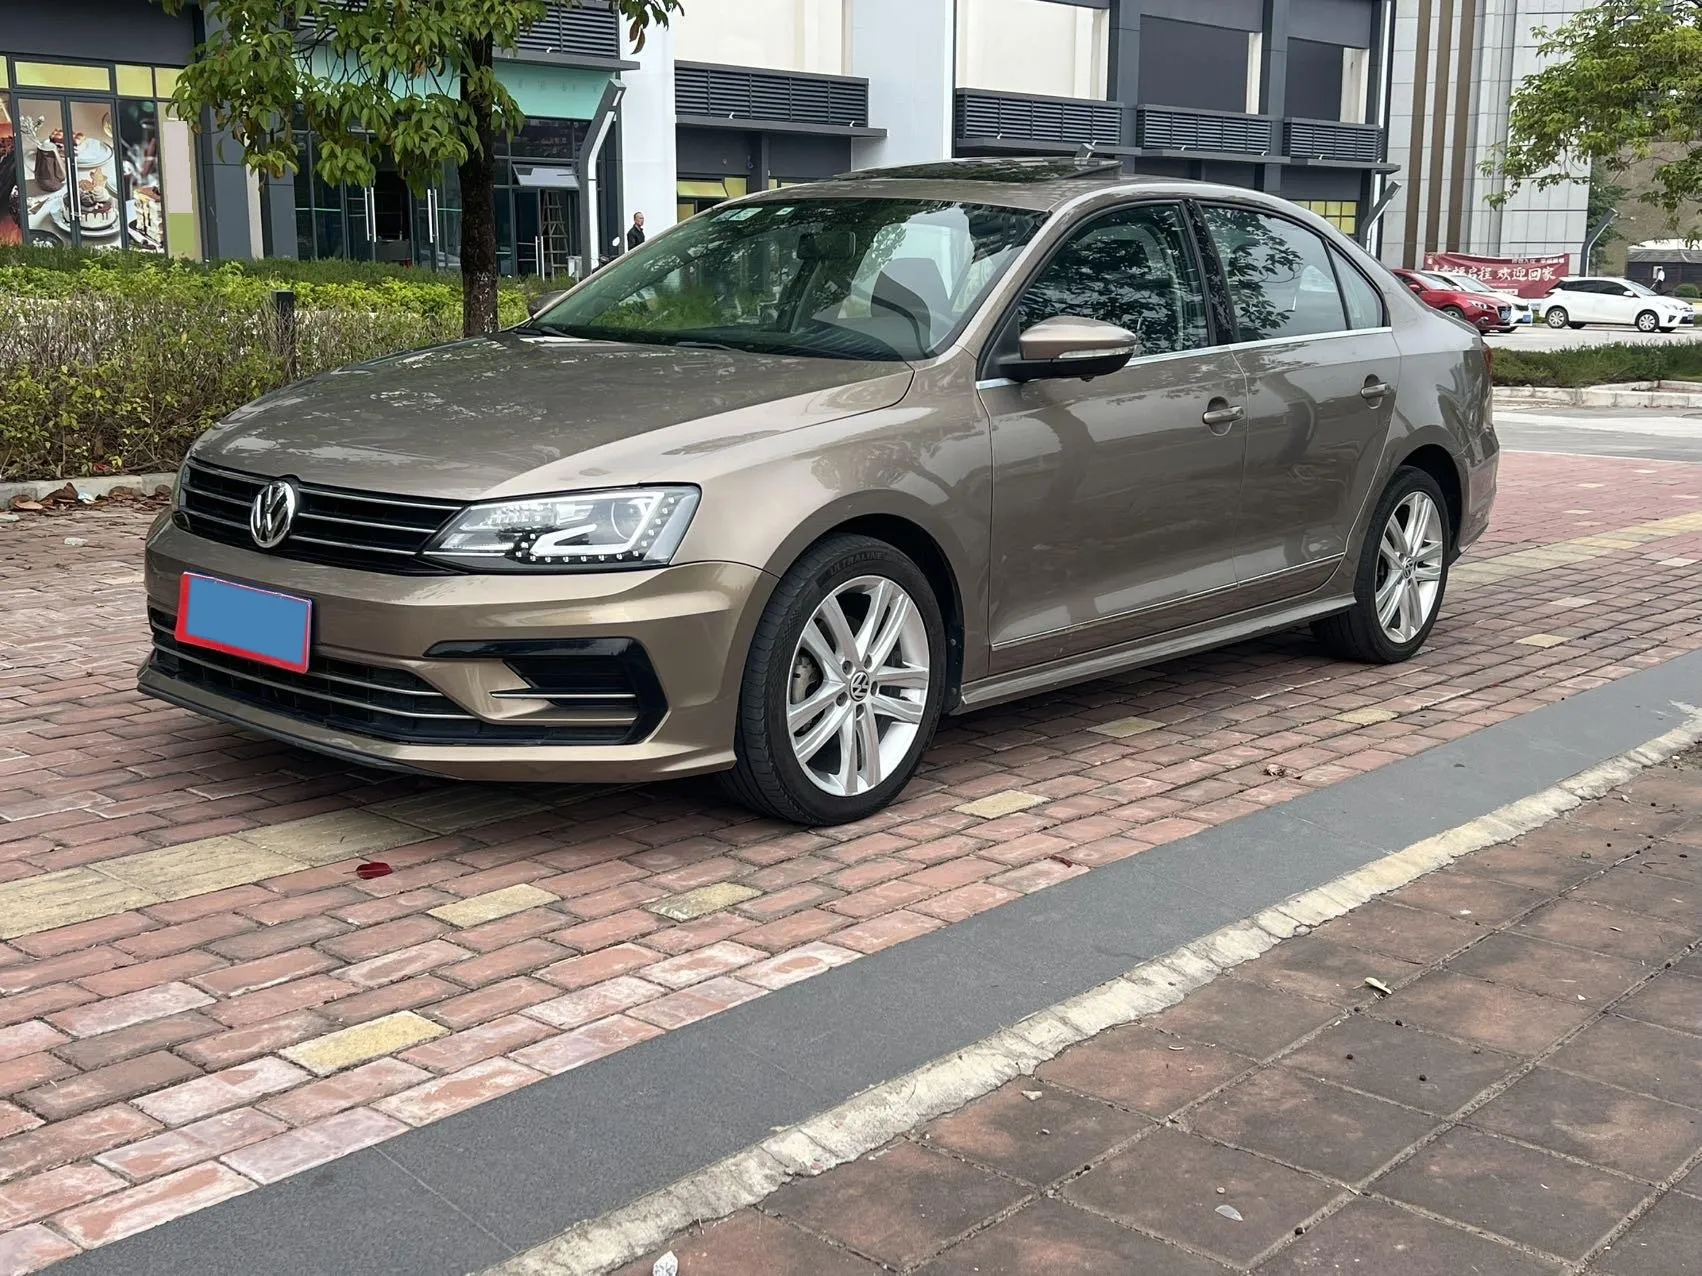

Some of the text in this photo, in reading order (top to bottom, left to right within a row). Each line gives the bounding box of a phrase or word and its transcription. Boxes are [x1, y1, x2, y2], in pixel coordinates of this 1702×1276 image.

[1496, 266, 1556, 282] 欢迎回家
[250, 481, 295, 549] VW
